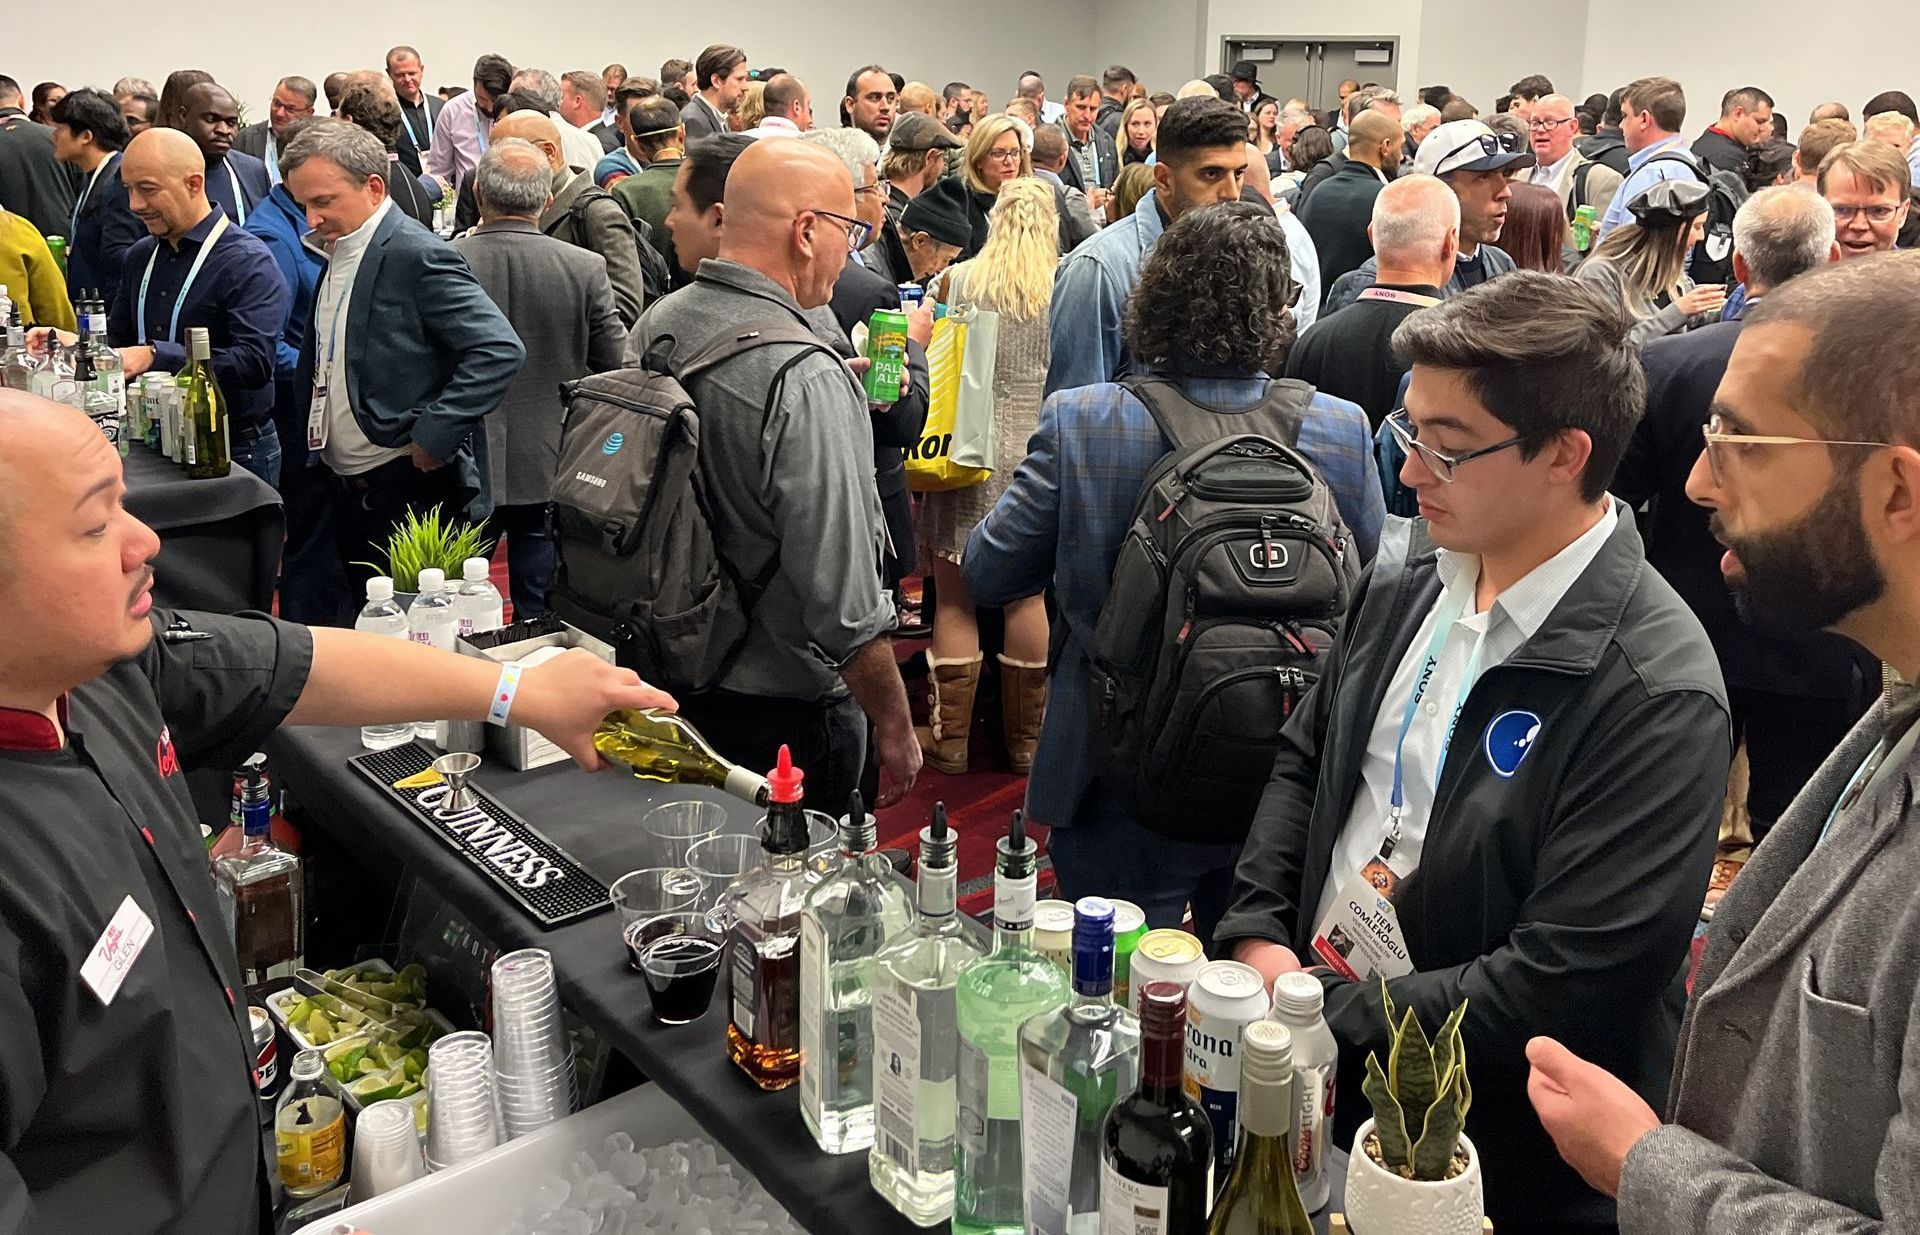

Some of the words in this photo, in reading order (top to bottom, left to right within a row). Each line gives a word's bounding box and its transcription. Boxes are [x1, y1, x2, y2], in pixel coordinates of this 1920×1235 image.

[1374, 290, 1396, 299] SONY
[877, 373, 901, 385] ALE
[575, 471, 607, 488] SAMSUNG
[1414, 655, 1438, 705] SONY
[416, 785, 565, 889] GUINNESS
[1349, 900, 1407, 961] COMLEKOGLU
[1374, 910, 1394, 934] TIEN
[114, 939, 136, 971] GLEN
[1372, 936, 1391, 960] HEALTH
[1302, 1083, 1315, 1128] LIGHT
